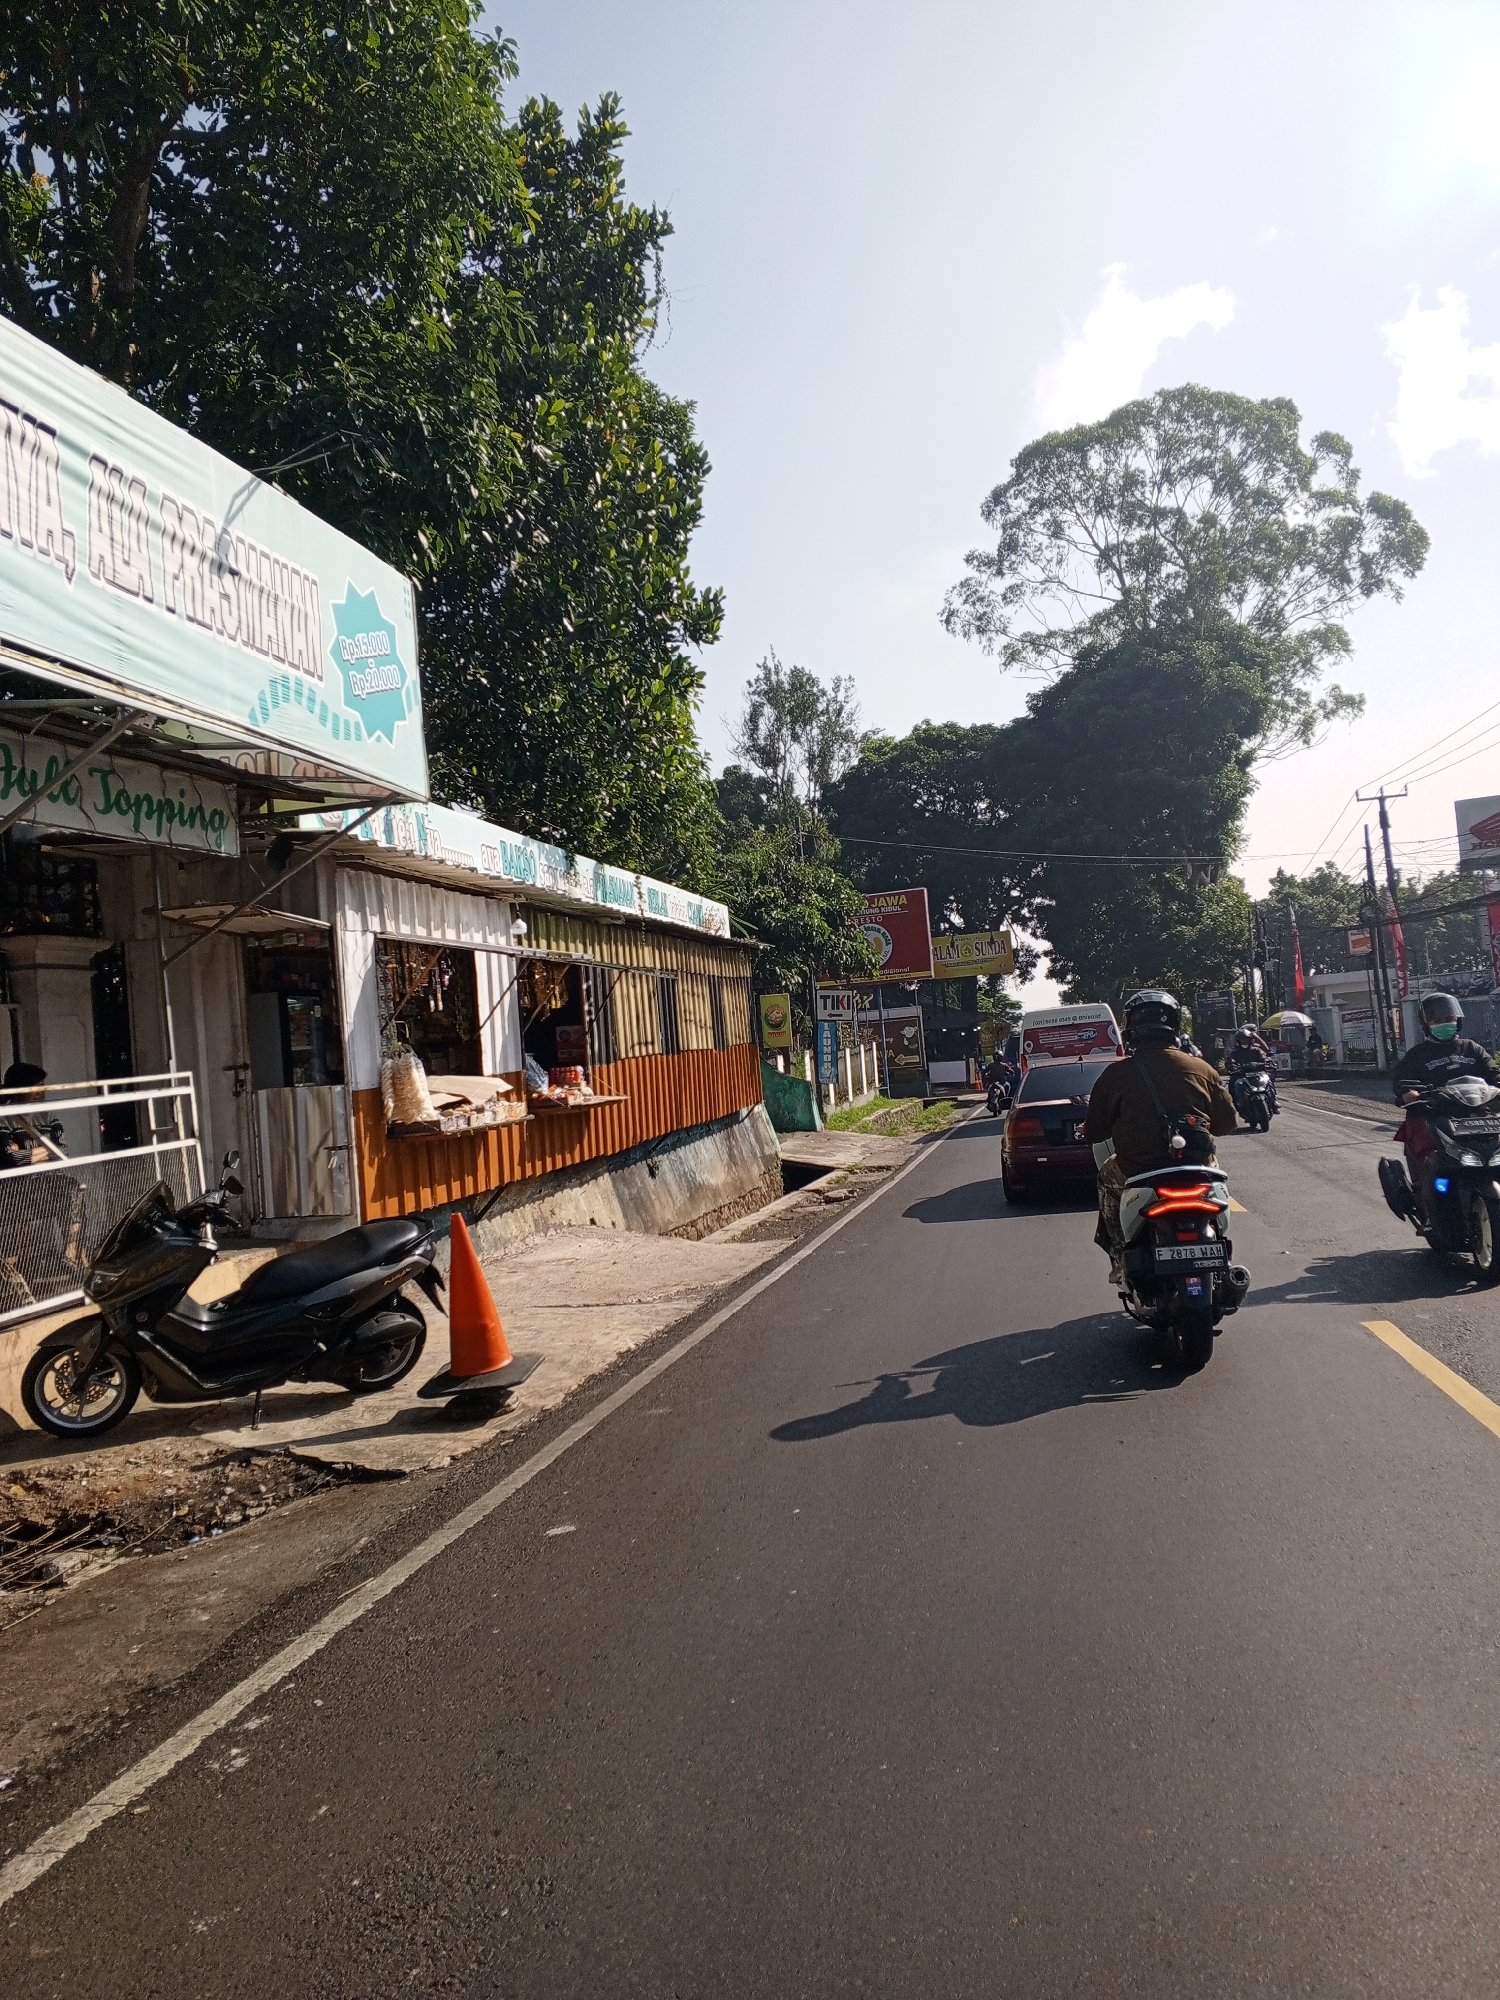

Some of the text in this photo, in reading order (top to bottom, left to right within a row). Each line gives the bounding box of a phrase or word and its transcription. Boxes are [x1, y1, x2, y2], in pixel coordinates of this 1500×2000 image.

[88, 451, 155, 604] ALA
[160, 491, 324, 684] PRASMANAN
[338, 631, 390, 664] Rp.15.000
[349, 665, 401, 698] Rp.20.000
[88, 766, 229, 849] Topping
[500, 839, 536, 885] BAKSO
[871, 894, 908, 908] JAWA
[881, 905, 902, 913] KIDUL
[854, 915, 883, 925] RESTO
[932, 940, 1007, 961] ALAM SUNDA
[820, 995, 850, 1010] TIKI
[823, 1022, 833, 1078] LAUNDRY
[1156, 1246, 1223, 1259] F 2878 WAH
